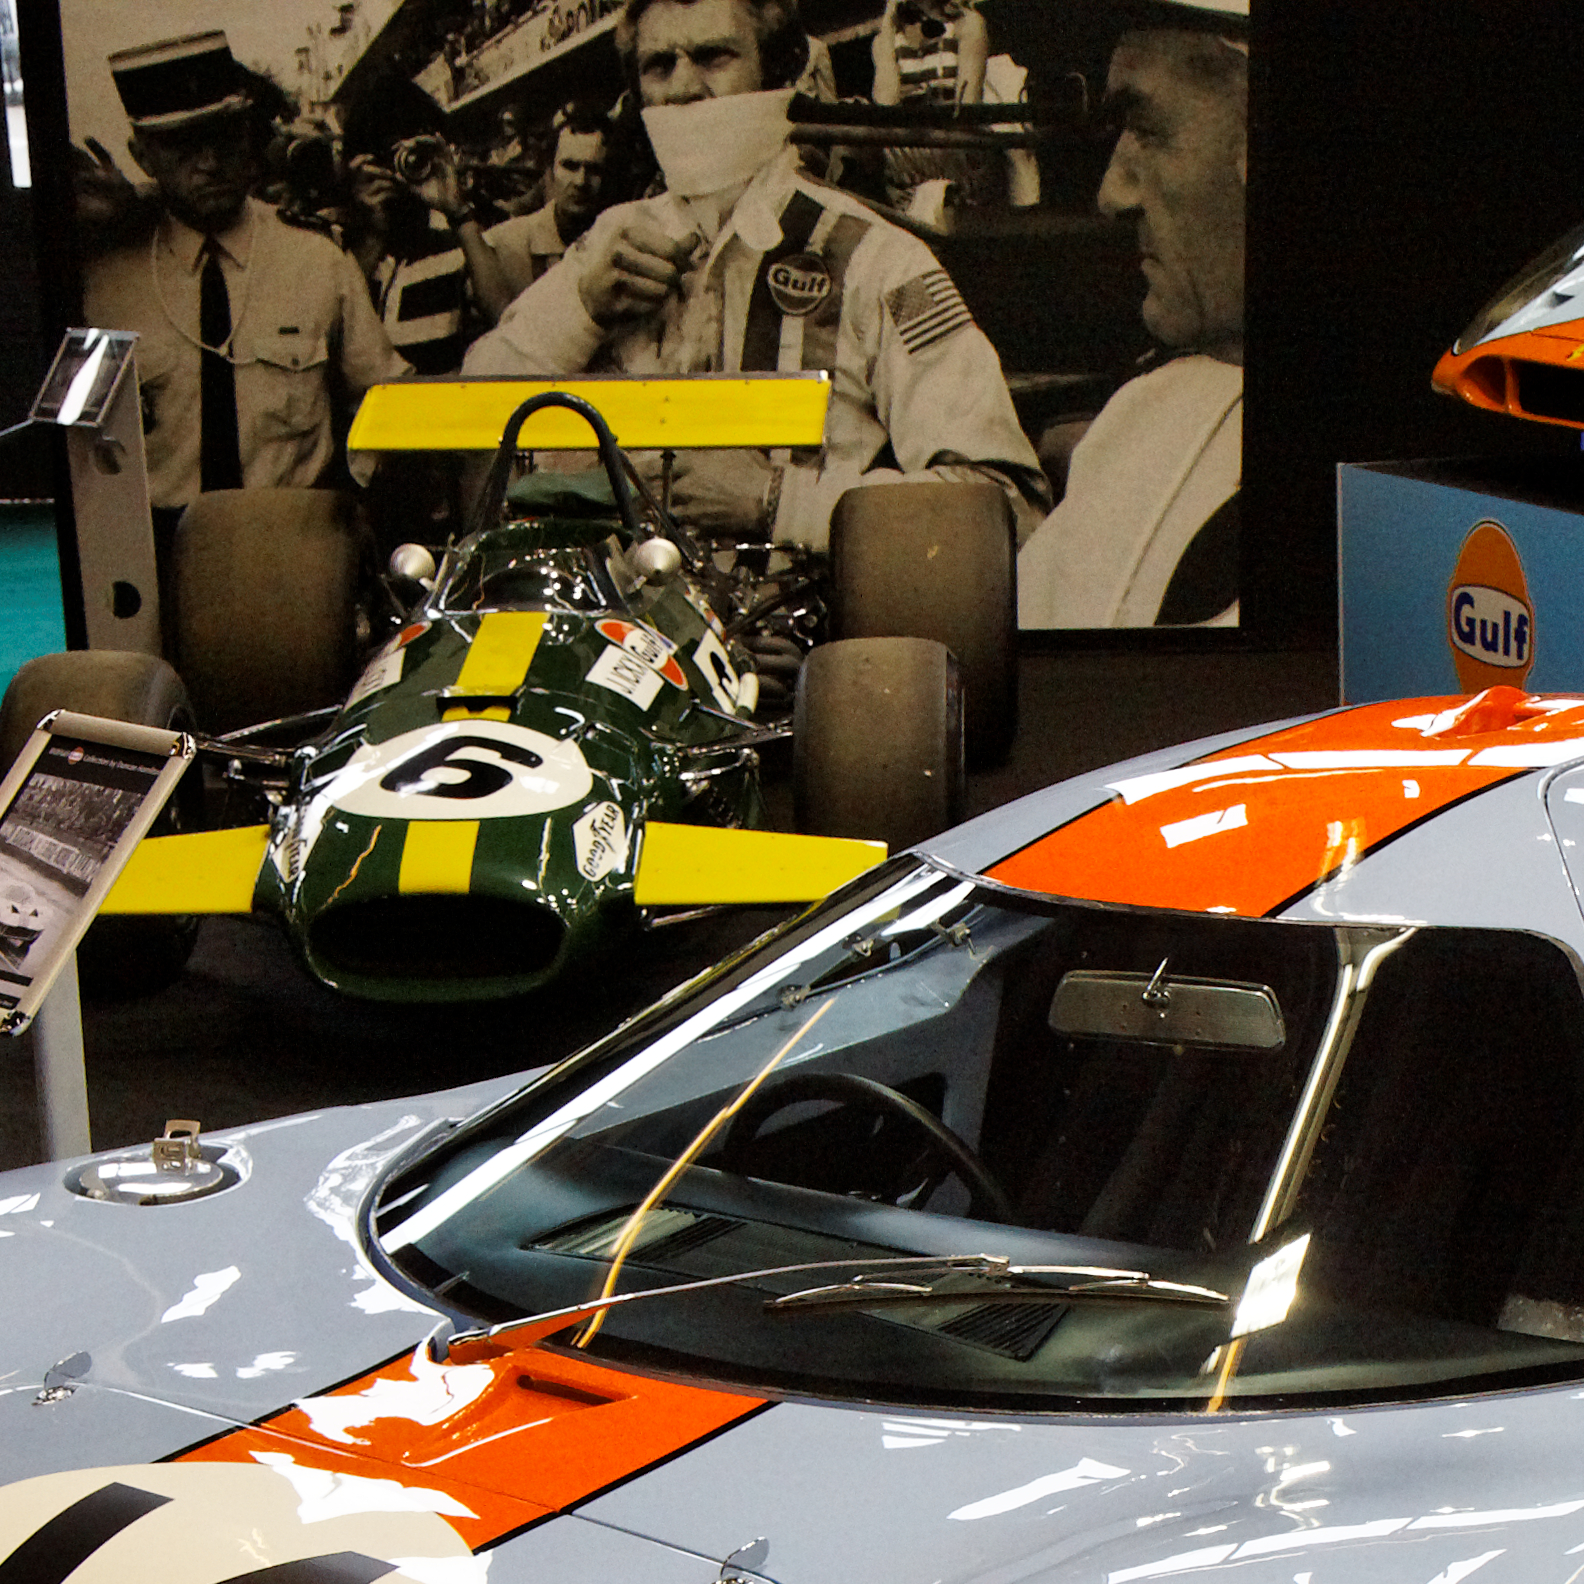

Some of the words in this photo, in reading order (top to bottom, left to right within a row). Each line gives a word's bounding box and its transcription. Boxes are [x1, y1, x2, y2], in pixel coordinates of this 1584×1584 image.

[772, 268, 827, 293] Gulf
[630, 631, 664, 664] Gulf
[1453, 592, 1529, 661] Gulf
[380, 735, 543, 800] 6
